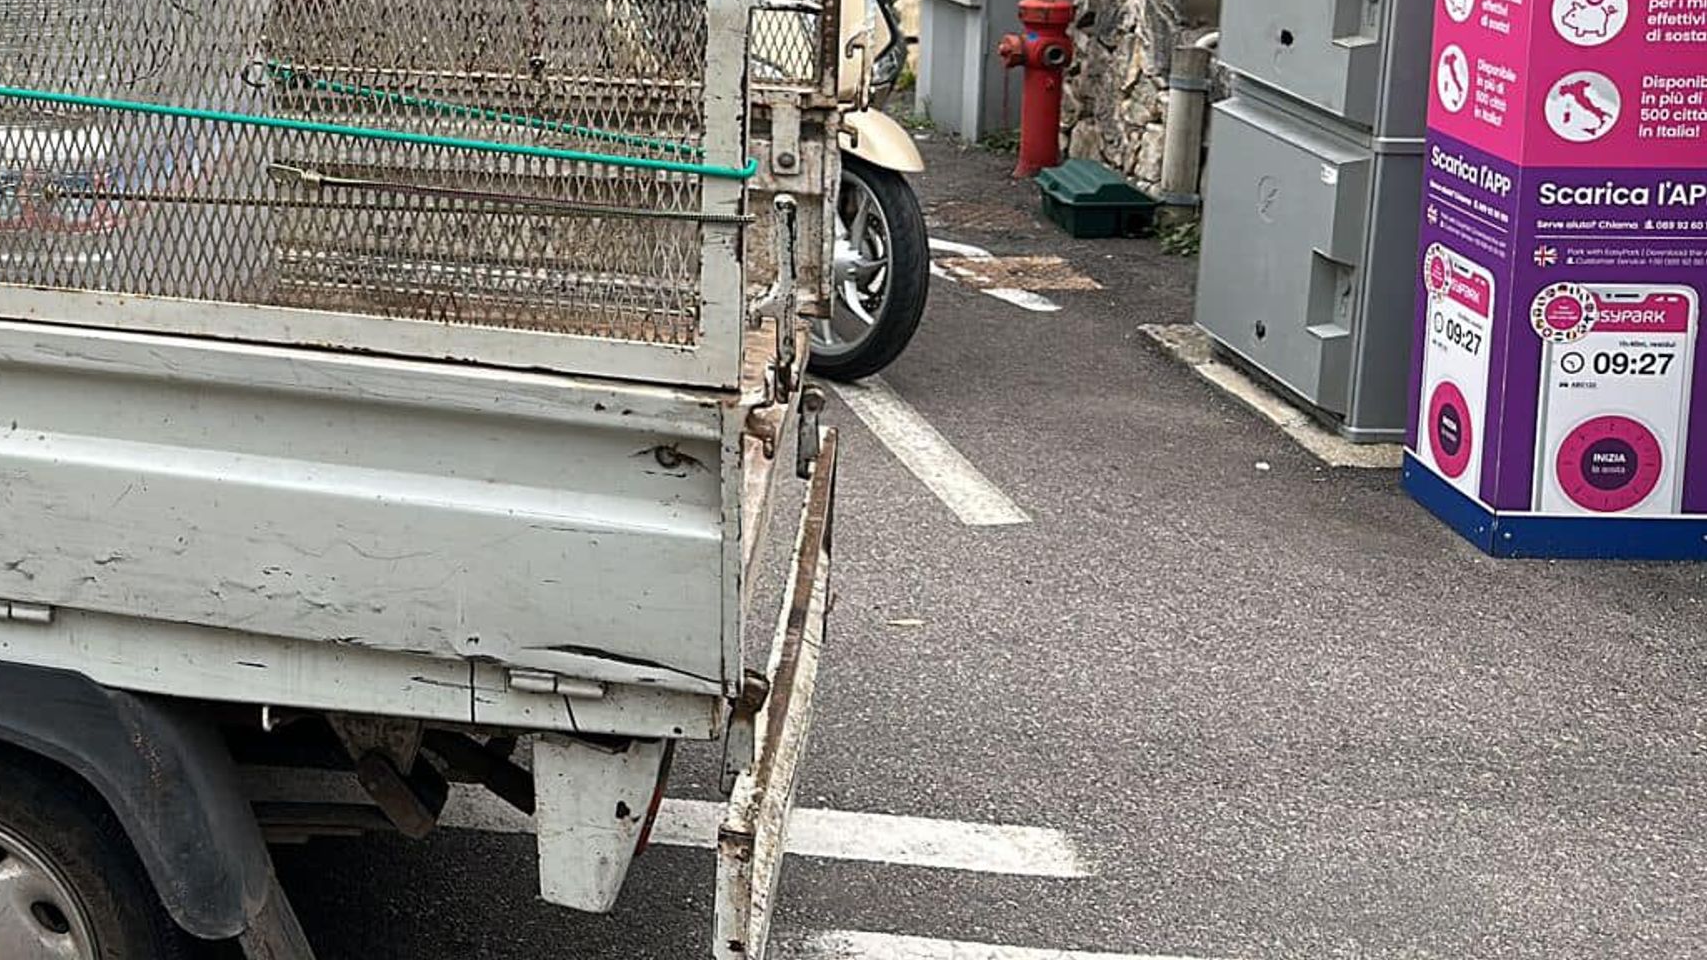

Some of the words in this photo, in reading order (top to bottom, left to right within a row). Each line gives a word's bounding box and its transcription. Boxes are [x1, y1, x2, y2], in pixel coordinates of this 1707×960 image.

[1647, 11, 1706, 25] effettivi
[1646, 27, 1661, 41] di
[1641, 92, 1656, 104] in
[1659, 91, 1684, 107] più
[1687, 92, 1702, 104] di
[1641, 109, 1670, 121] 500
[1656, 125, 1700, 138] Italia!
[1431, 145, 1478, 184] Scarica
[1540, 183, 1649, 205] Scarica
[1657, 181, 1707, 205] l'AP
[1446, 319, 1482, 356] 09:27
[1594, 352, 1675, 375] 09:27
[1593, 453, 1626, 462] INIZIA
